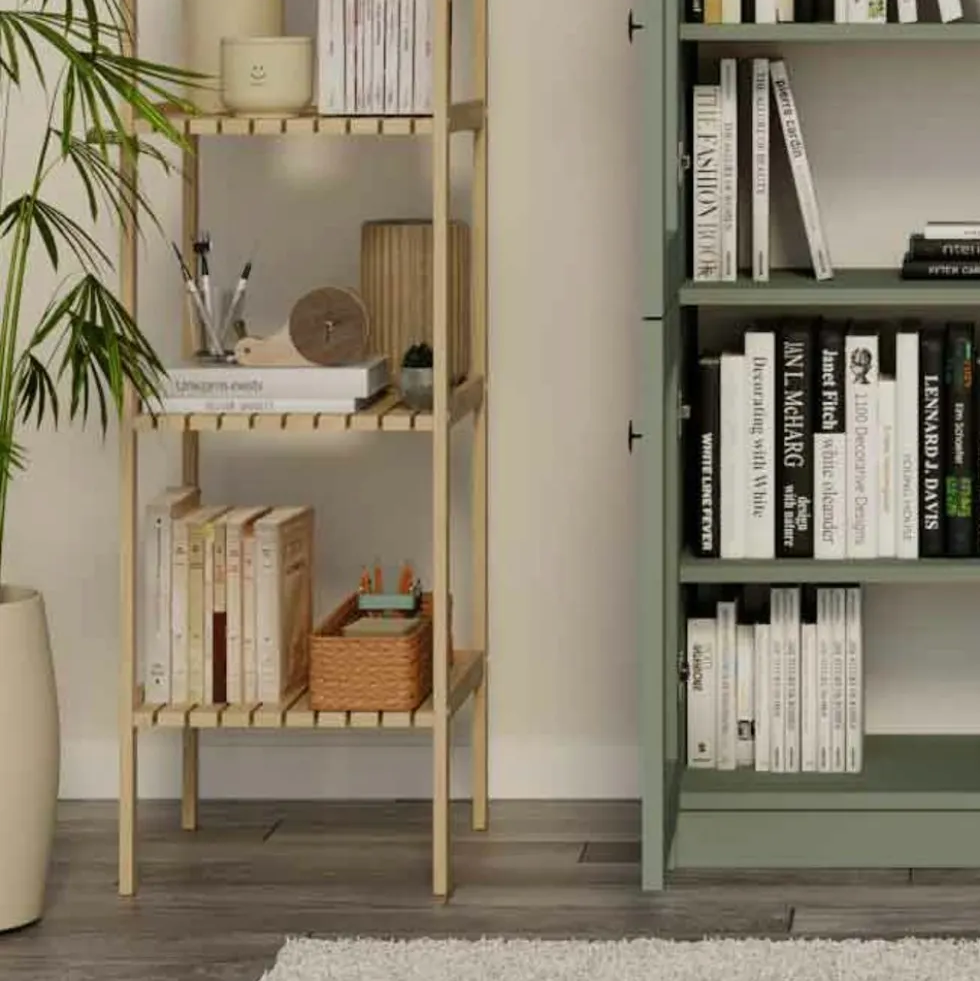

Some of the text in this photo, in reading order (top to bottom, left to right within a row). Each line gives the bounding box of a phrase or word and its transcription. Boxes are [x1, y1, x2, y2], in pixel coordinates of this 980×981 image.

[697, 134, 718, 217] FASHION
[784, 390, 804, 468] McHARG
[822, 348, 838, 430] Janet Fitch
[924, 375, 939, 457] LENNARD
[750, 356, 767, 518] Decorating with White
[822, 438, 838, 479] white
[701, 432, 712, 551] WHITE LINE FEVER
[784, 484, 796, 508] with
[799, 496, 811, 531] design
[924, 478, 939, 530] DAVIS
